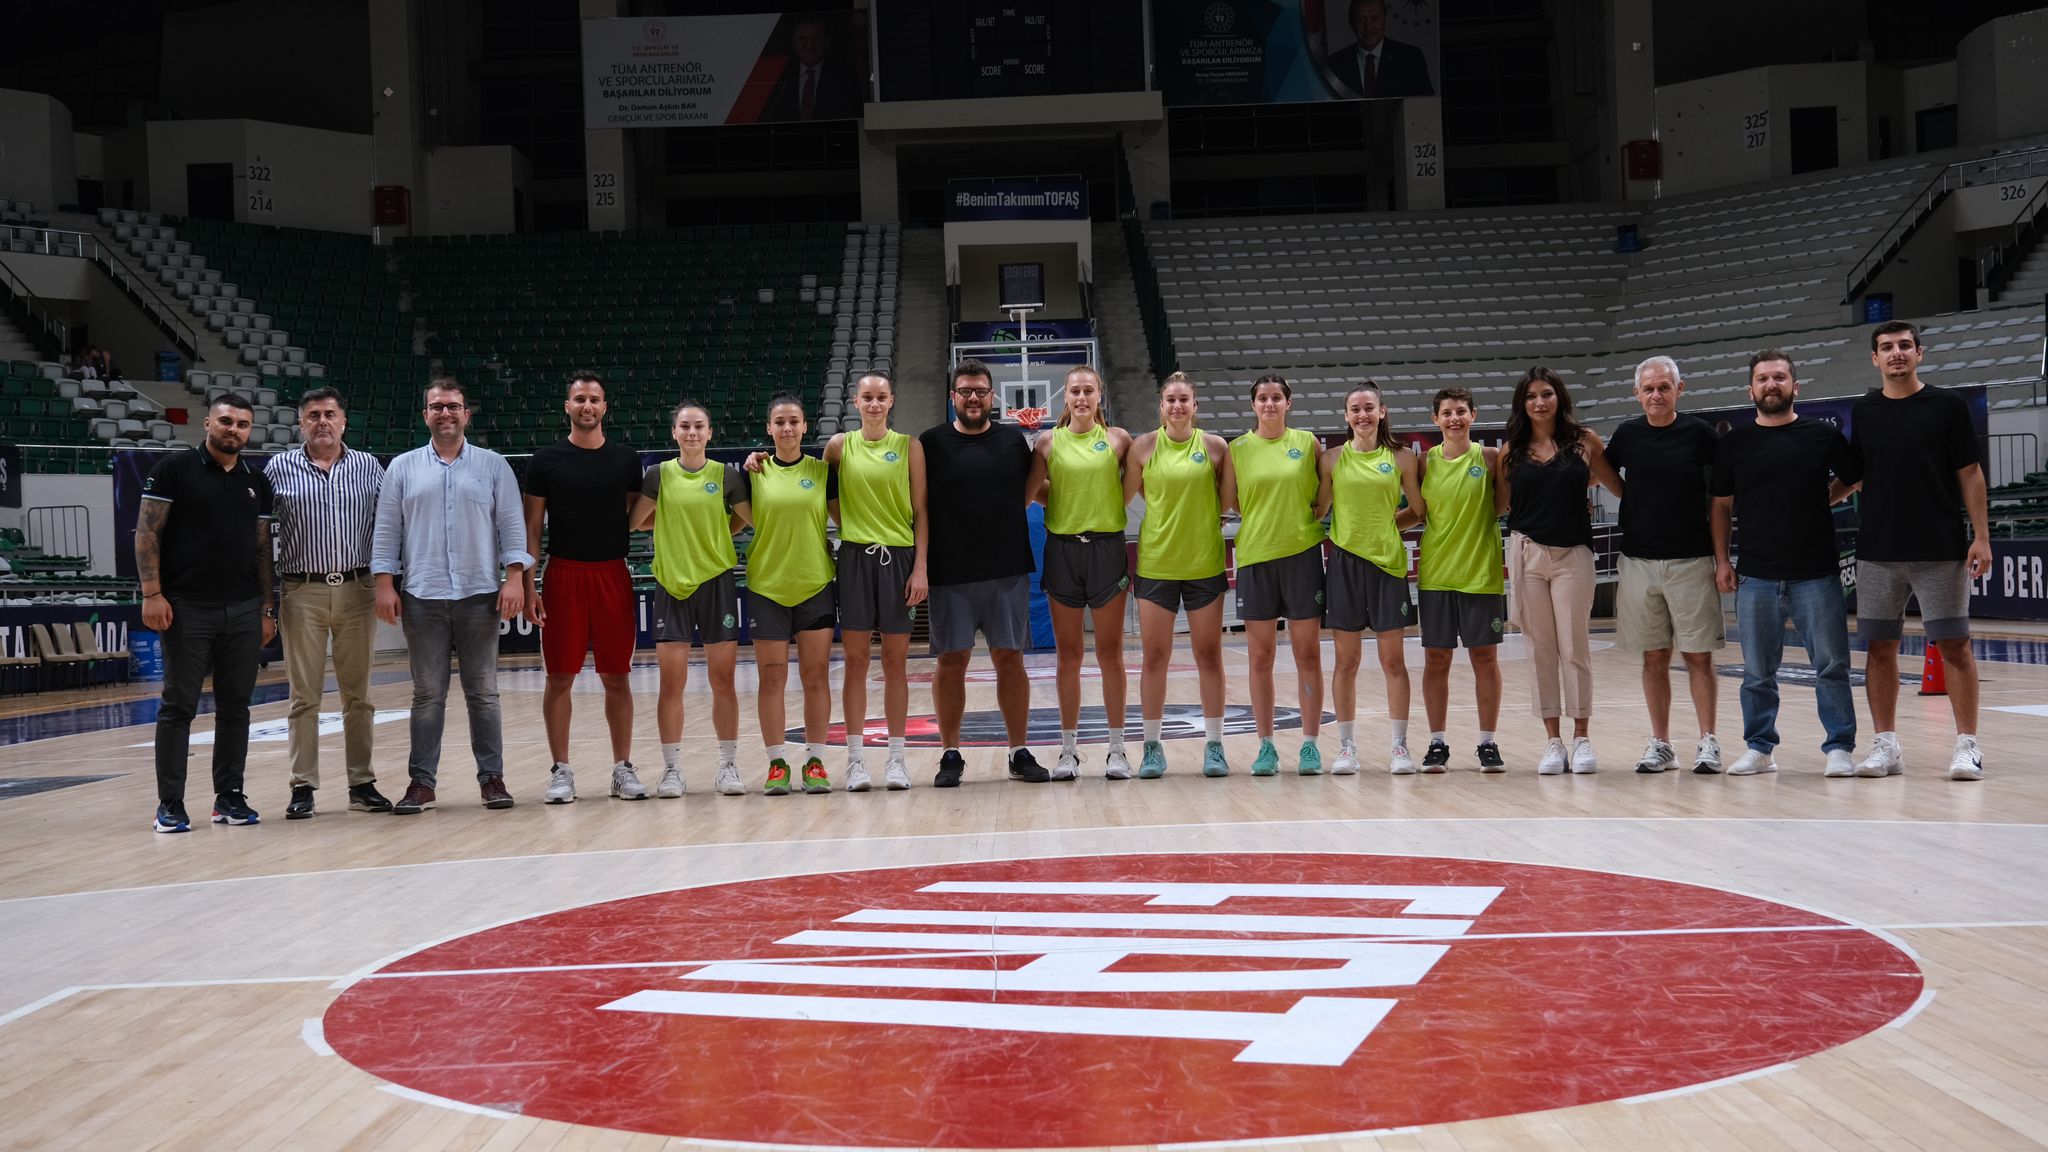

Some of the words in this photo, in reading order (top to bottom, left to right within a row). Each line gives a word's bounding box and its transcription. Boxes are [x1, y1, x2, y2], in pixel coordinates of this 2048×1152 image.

[1189, 40, 1208, 48] TÜM
[611, 62, 636, 74] TÜM
[640, 62, 702, 74] ANTRENÖR
[982, 66, 1002, 76] SCORE
[1024, 64, 1045, 74] SCORE
[598, 76, 612, 86] VE
[615, 74, 715, 86] SPORCULARIMIZA
[603, 88, 656, 99] BAŞARILAR
[658, 86, 712, 97] DİLİYORUM
[608, 114, 642, 124] GENÇLİK
[644, 114, 654, 122] VE
[656, 113, 676, 122] SPOR
[678, 112, 709, 121] BAKANI
[1744, 112, 1766, 130] 325
[1747, 132, 1766, 148] 217
[1414, 144, 1436, 158] 324
[249, 166, 272, 182] 322
[1417, 162, 1436, 176] 216
[594, 174, 614, 188] 323
[596, 192, 614, 206] 215
[956, 190, 1080, 210] #BenimTakımımTOFAŞ
[2001, 184, 2026, 202] 326
[250, 196, 272, 212] 214
[2003, 556, 2048, 598] BER
[596, 880, 1504, 1067] FIAT
